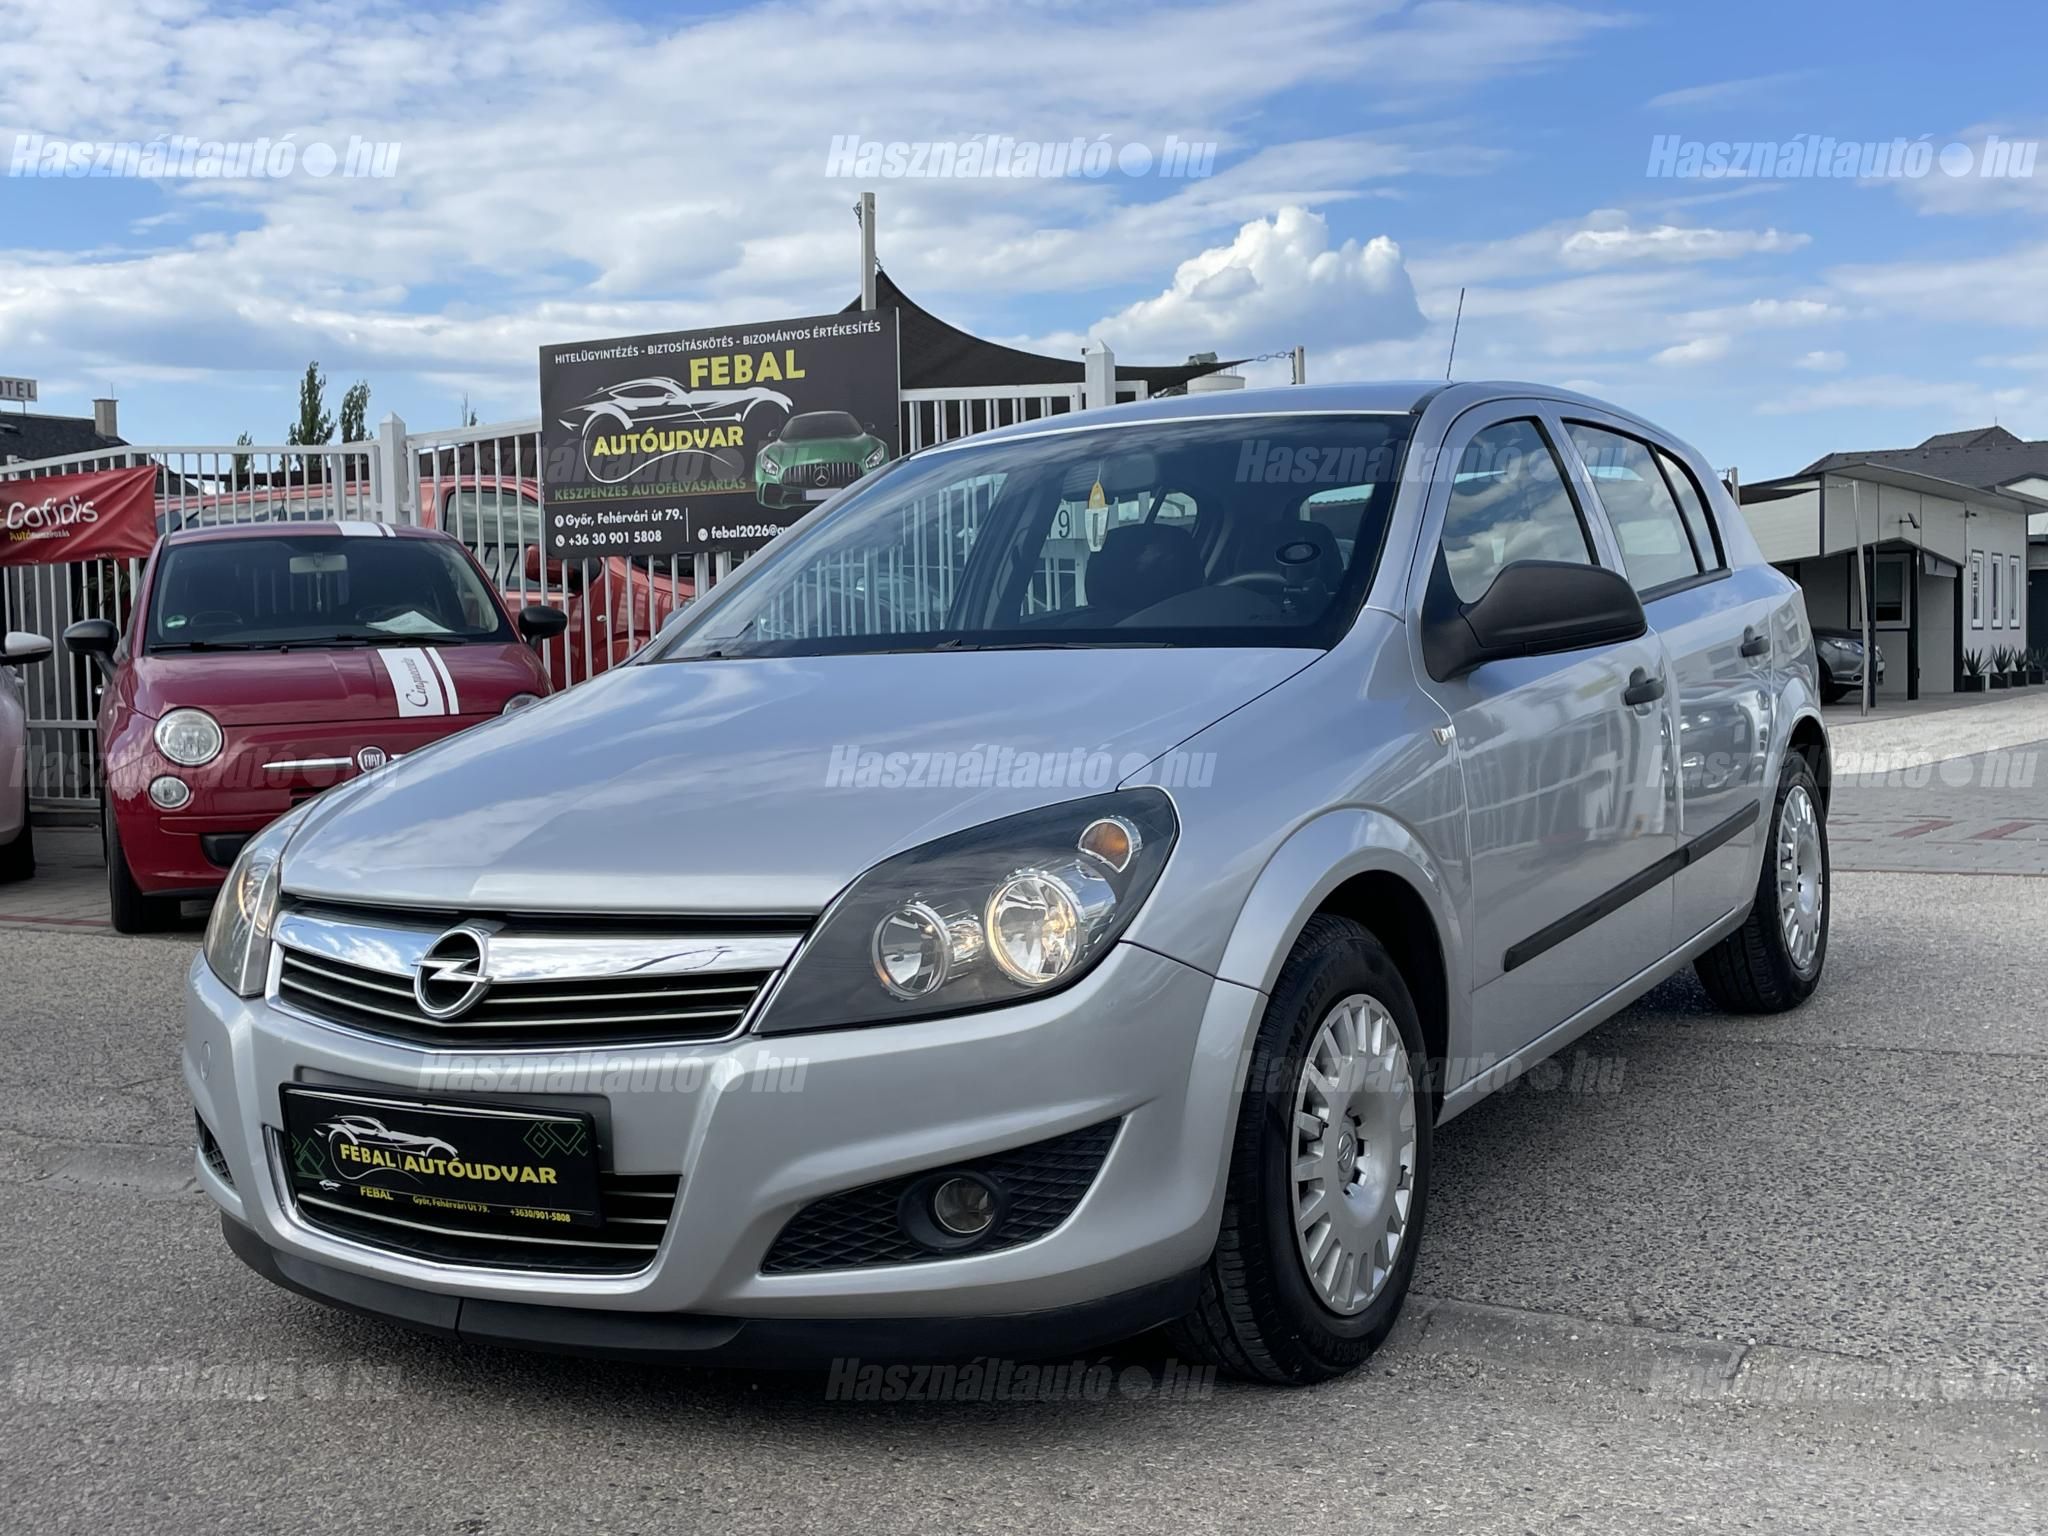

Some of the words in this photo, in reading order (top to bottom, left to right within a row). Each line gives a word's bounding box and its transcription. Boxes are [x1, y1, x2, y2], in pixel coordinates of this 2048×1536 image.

[555, 346, 639, 364] HITELÜGYINTÉZÉS
[647, 336, 734, 355] BIZTOSÍTÁSKÖTÉS
[743, 328, 811, 346] BIZOMÁNYOS
[813, 321, 881, 338] ÉRTÉKESÍTÉS
[690, 350, 806, 388] FEBAL
[592, 425, 744, 456] AUTÓUDVAR
[6, 495, 98, 530] Cofidis
[565, 514, 595, 528] Győr,
[598, 509, 649, 525] Fehérvári
[652, 508, 663, 522] út
[665, 509, 683, 521] 79.
[1058, 510, 1070, 538] 9
[569, 534, 589, 546] +36
[592, 533, 606, 545] 30
[608, 533, 629, 544] 901
[633, 530, 662, 543] 5808
[363, 753, 381, 767] FIAT
[340, 1143, 397, 1168] FEBAL
[403, 1157, 558, 1184] AUTÓUDVAR
[360, 1186, 394, 1201] FEBAL
[510, 1208, 571, 1222] +3630/901-5808
